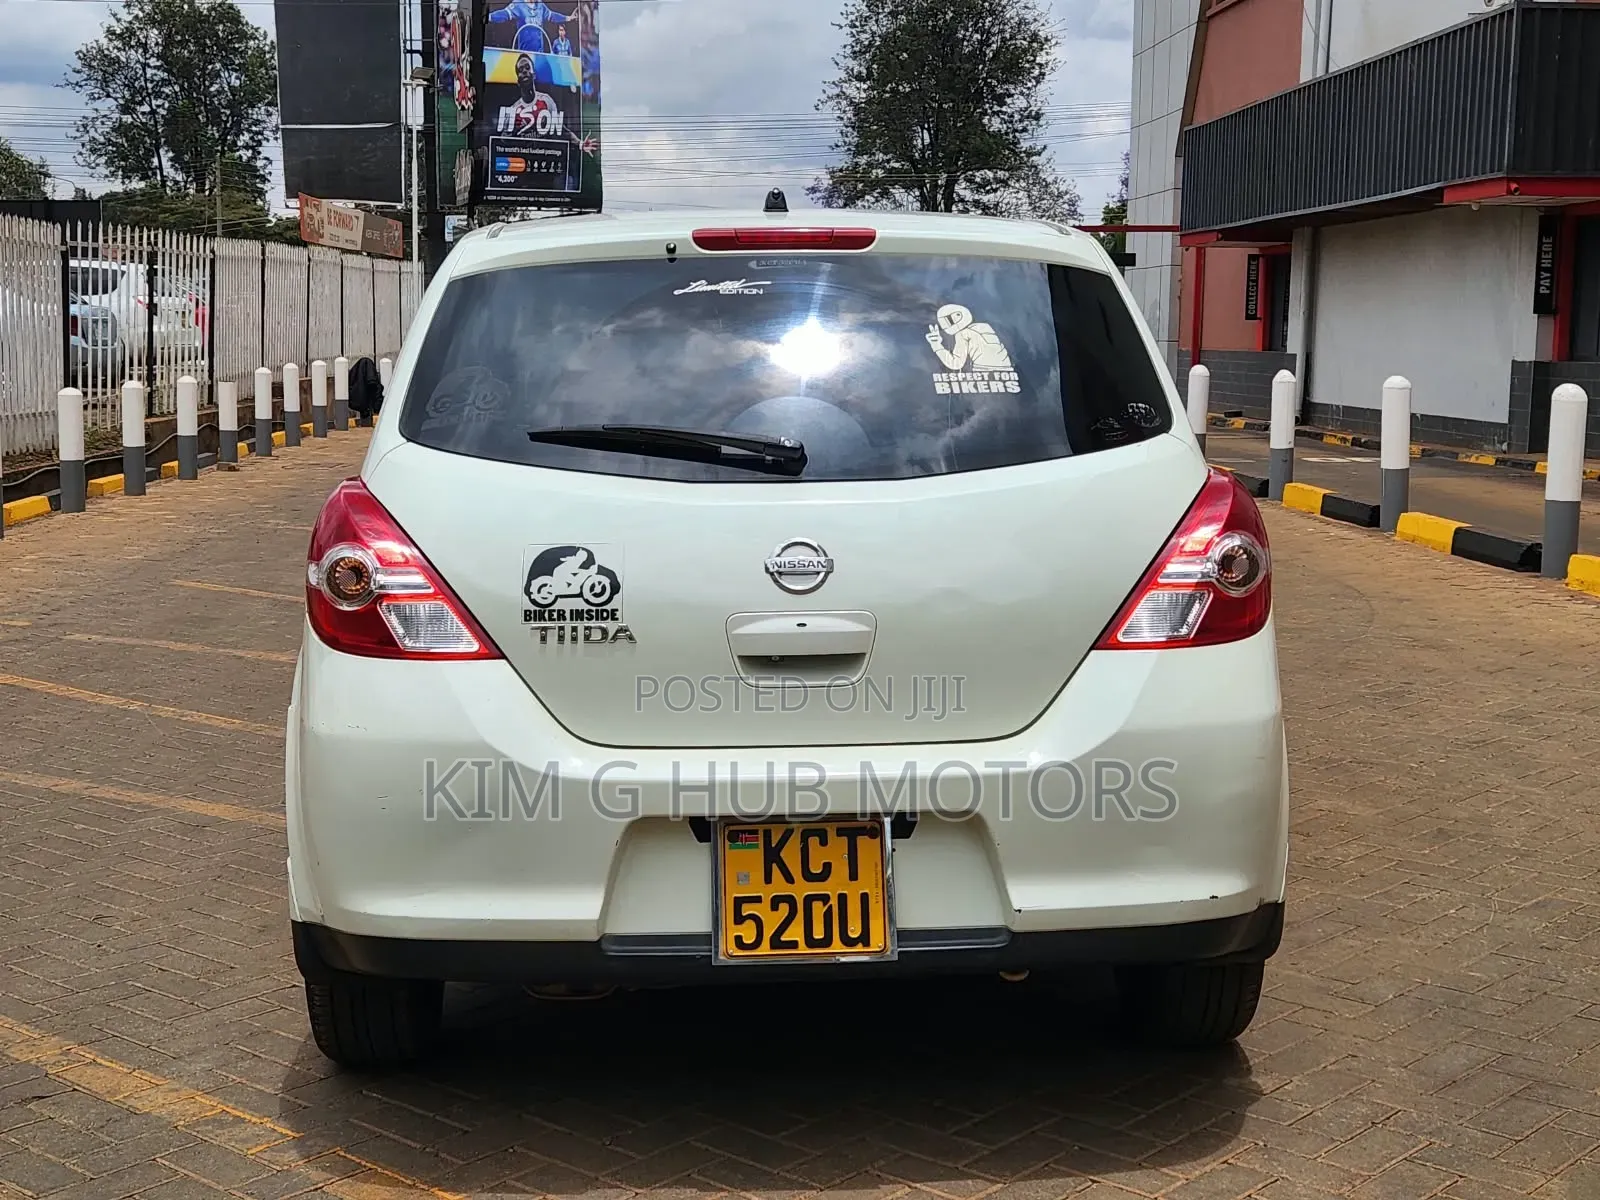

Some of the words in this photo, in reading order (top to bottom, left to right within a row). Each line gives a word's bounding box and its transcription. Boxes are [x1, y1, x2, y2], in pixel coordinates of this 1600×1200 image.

[536, 109, 564, 136] ON
[1541, 236, 1553, 267] HERE
[1539, 271, 1551, 294] PAY
[1247, 281, 1257, 315] COLLECT
[932, 372, 989, 381] RESPECT
[993, 371, 1019, 380] FOR
[934, 380, 1021, 394] BIKERS
[770, 560, 828, 570] NISSAN
[523, 609, 567, 622] BIKER
[569, 608, 619, 622] INSIDE
[530, 623, 638, 645] TIIDA
[762, 826, 878, 885] KCT
[733, 892, 871, 951] 520U
